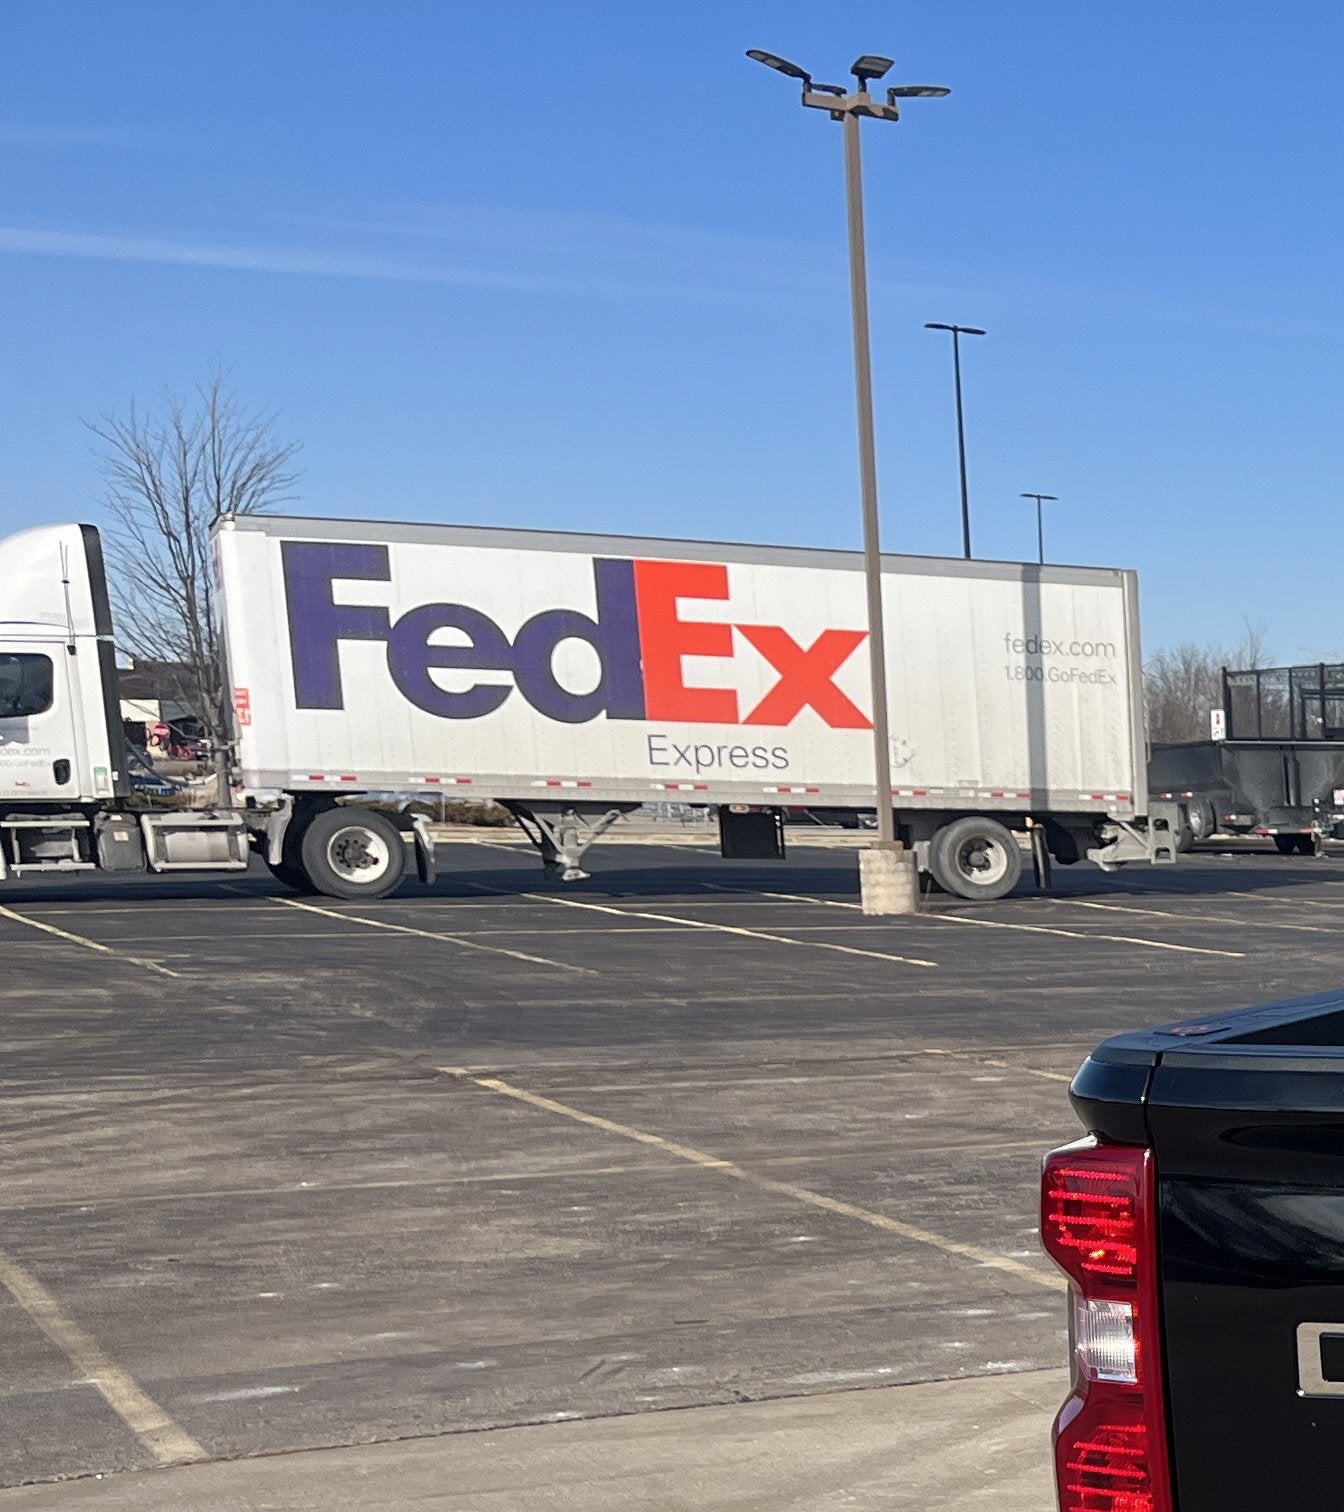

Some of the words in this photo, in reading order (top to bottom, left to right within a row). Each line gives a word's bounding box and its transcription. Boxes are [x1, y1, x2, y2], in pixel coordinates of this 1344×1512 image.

[280, 540, 874, 730] FedEx
[1003, 632, 1116, 658] fedex.com
[1004, 665, 1118, 685] 1.800.GoFedEx
[647, 733, 790, 775] Express
